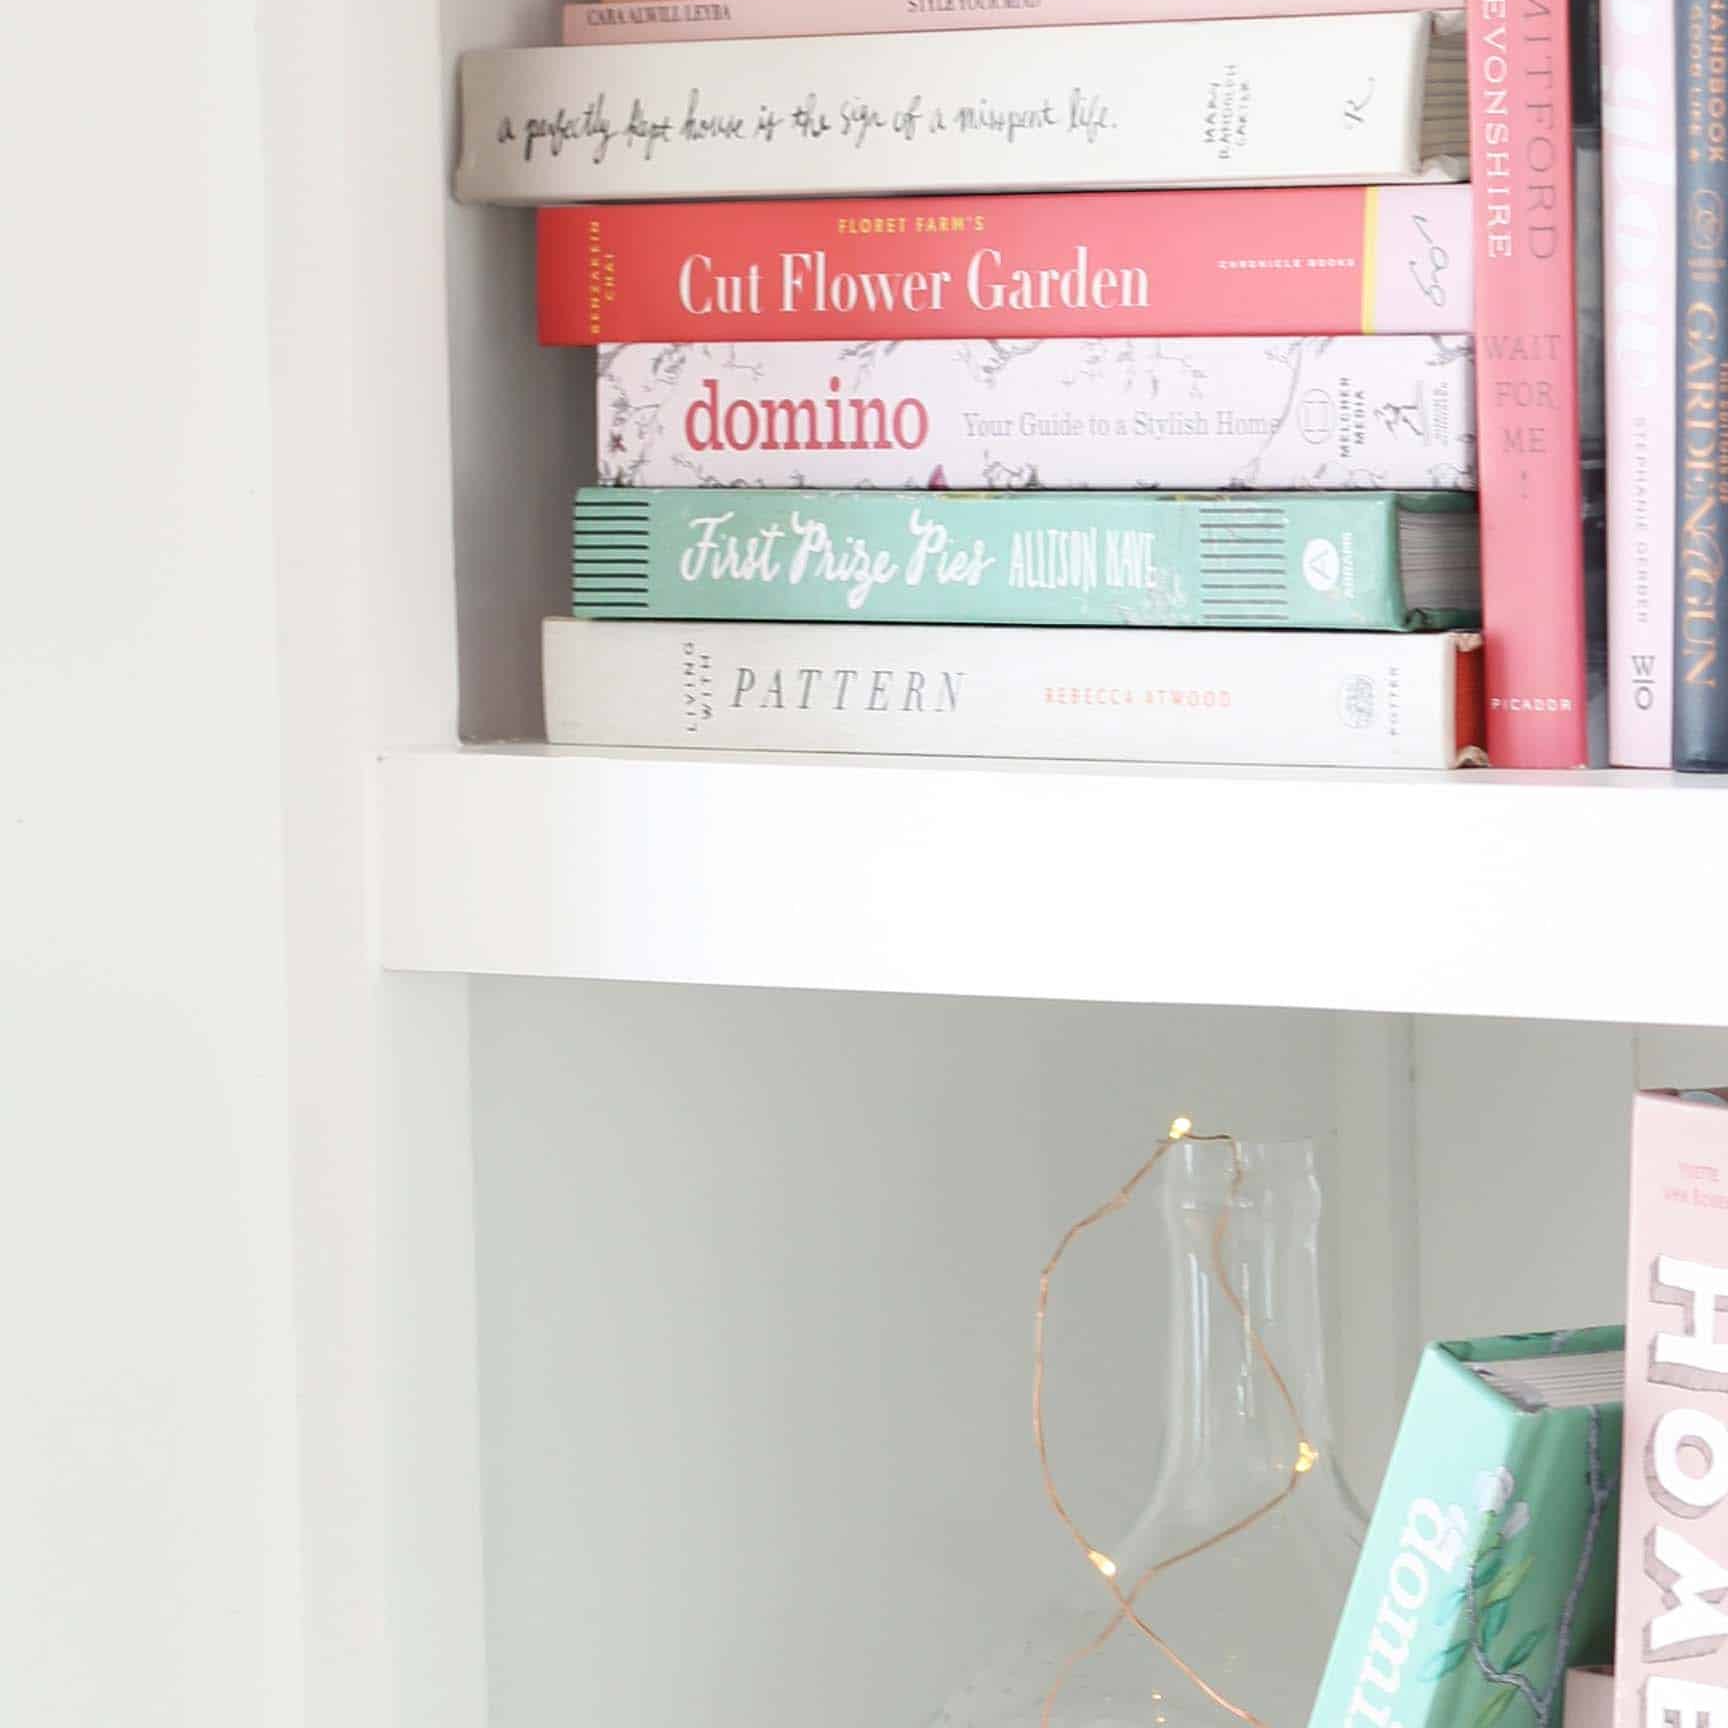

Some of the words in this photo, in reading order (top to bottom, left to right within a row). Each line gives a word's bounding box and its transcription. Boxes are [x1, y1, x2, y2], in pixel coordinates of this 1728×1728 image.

[838, 218, 906, 234] FLORET
[915, 216, 985, 233] FARM'S
[1216, 258, 1302, 269] CHRONICLE
[679, 253, 761, 314] Cut
[779, 249, 951, 312] Flower
[966, 246, 1151, 310] Garden
[1483, 335, 1560, 362] WAIT
[1496, 381, 1557, 409] FOR
[685, 376, 929, 451] domino
[961, 412, 1013, 438] Your
[1019, 409, 1083, 437] Guide
[1088, 413, 1111, 436] to
[1116, 419, 1129, 435] a
[1134, 409, 1208, 439] Stylish
[1216, 410, 1281, 436] Home
[1502, 427, 1545, 454] ME
[680, 512, 785, 582] First
[790, 511, 899, 609] Prize
[905, 508, 995, 586] Pies
[1009, 527, 1097, 591] ALLISON
[681, 641, 697, 732] LIVING
[700, 654, 713, 719] WITH
[729, 668, 967, 712] PATTERN
[1044, 687, 1135, 707] REBECCA
[1143, 688, 1231, 709] ATWOOD
[1491, 697, 1572, 712] PICADOR
